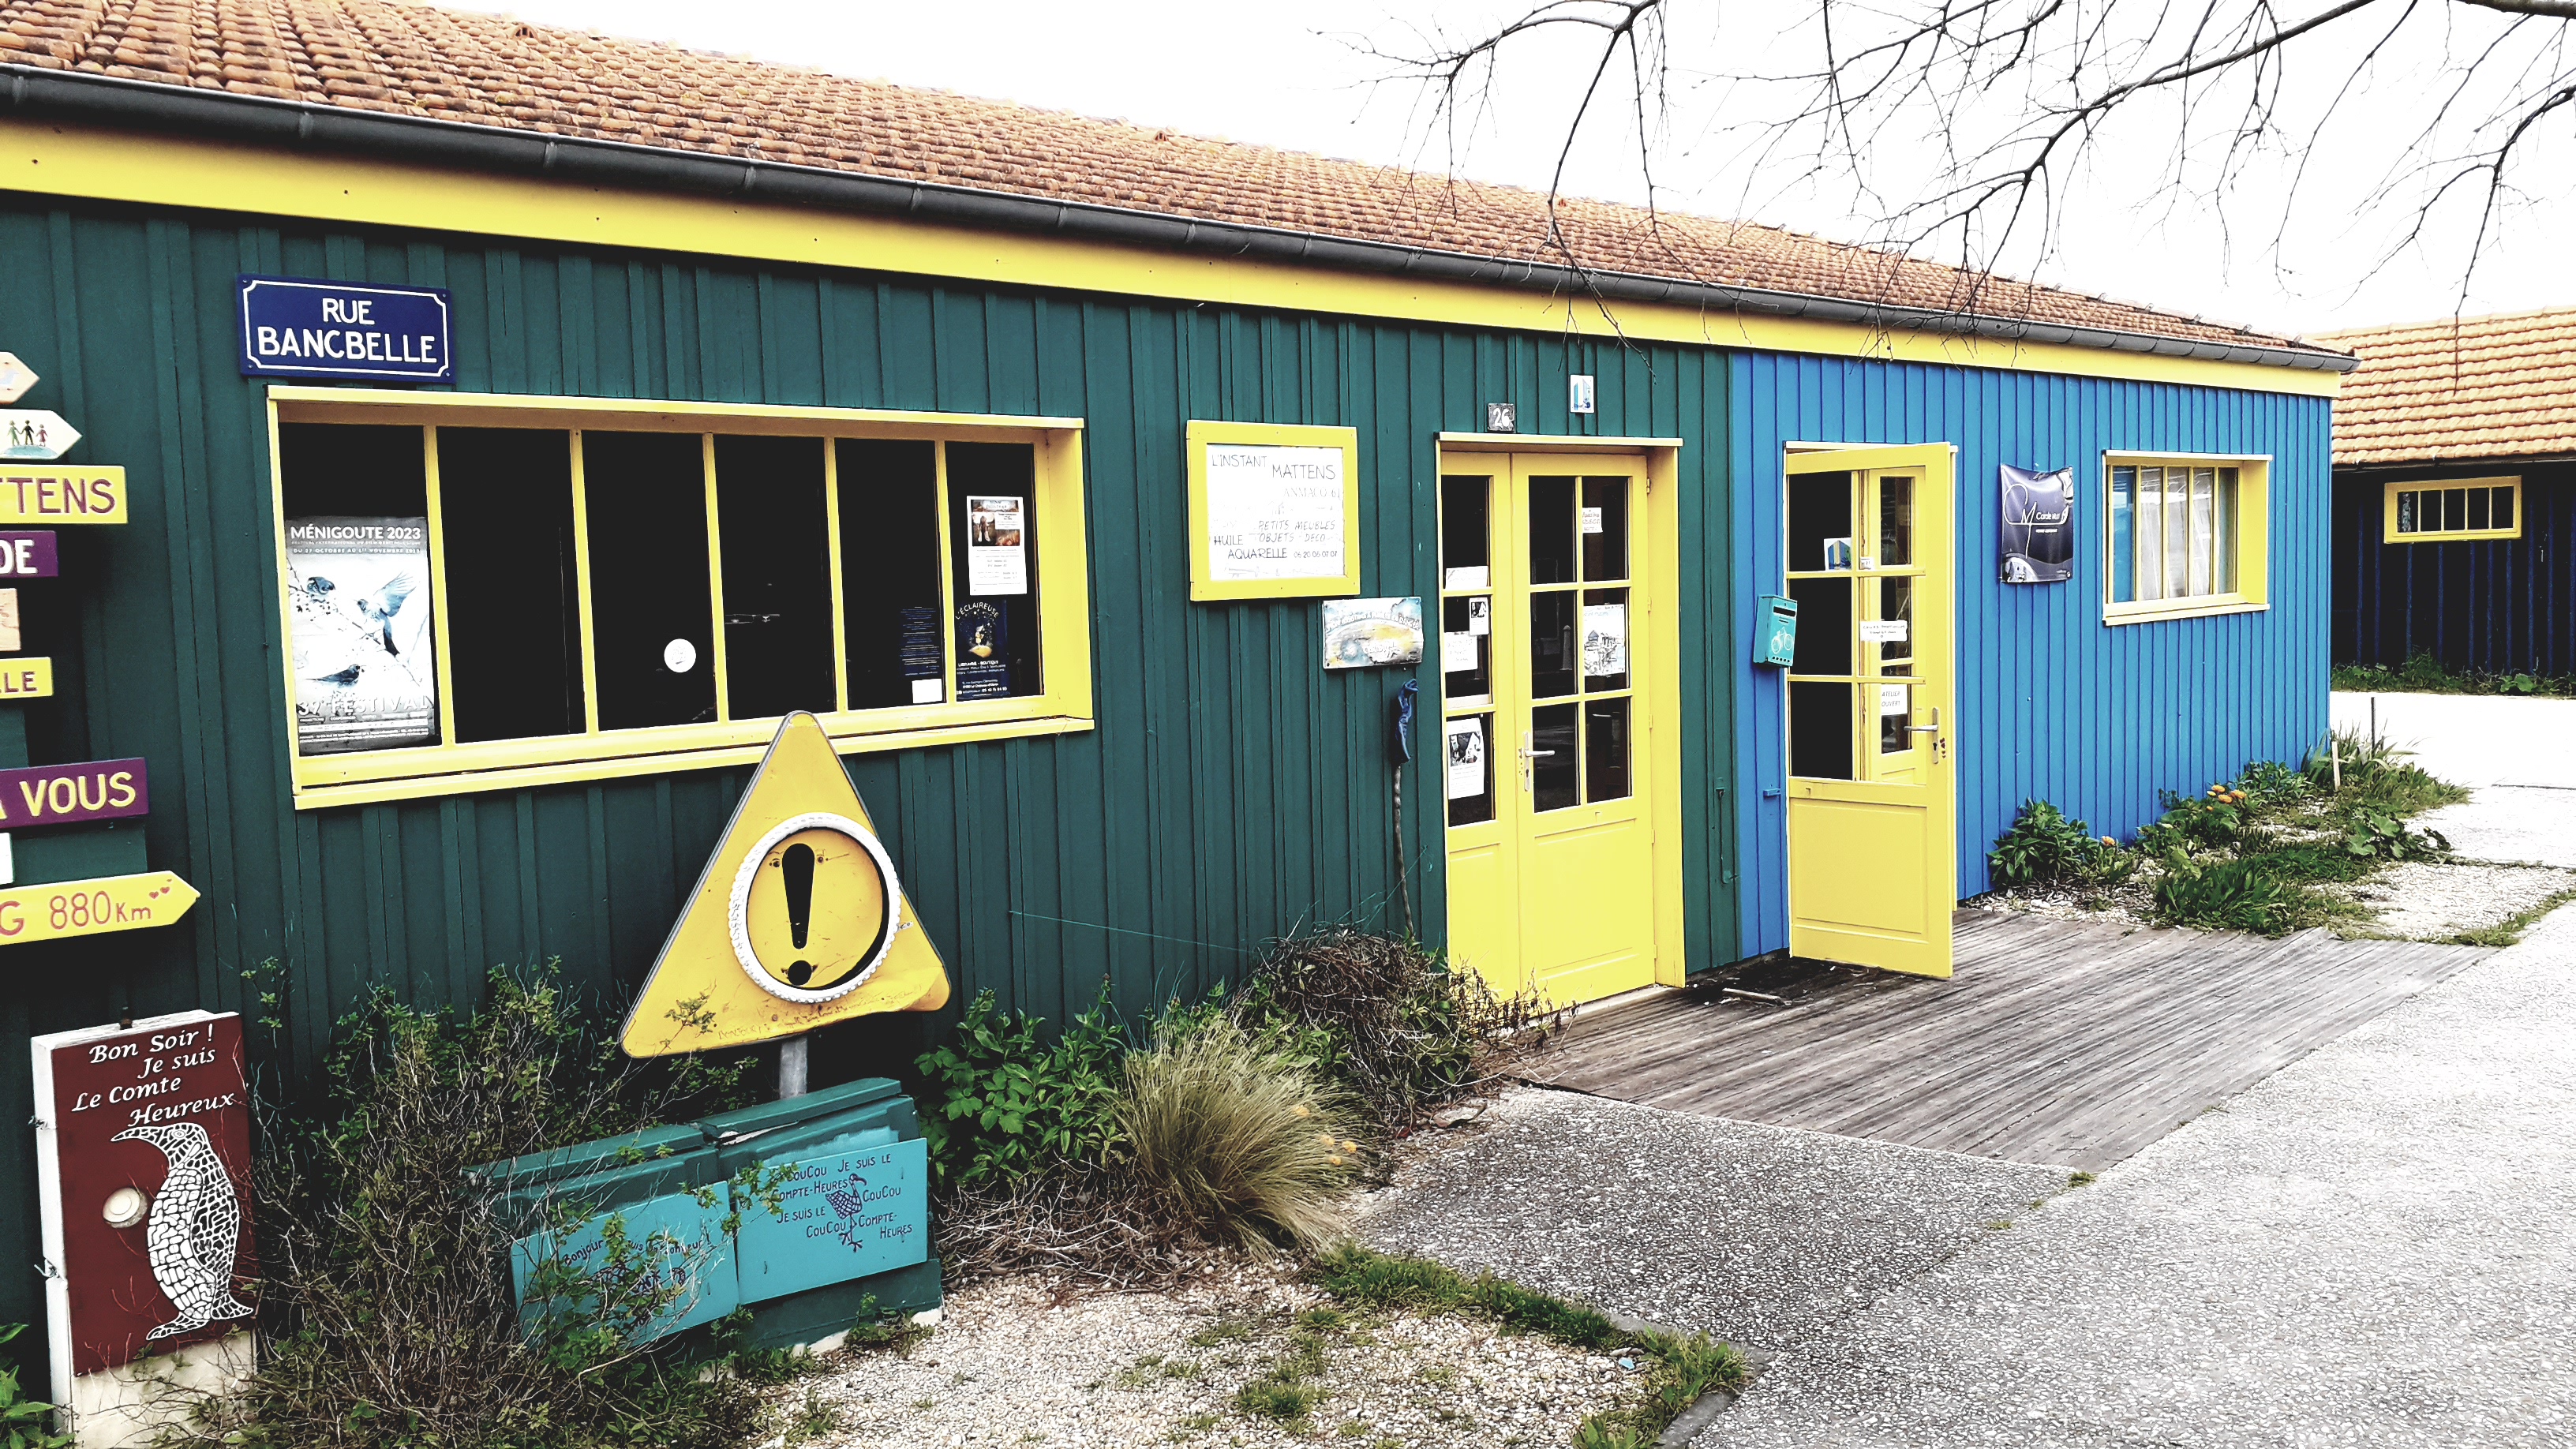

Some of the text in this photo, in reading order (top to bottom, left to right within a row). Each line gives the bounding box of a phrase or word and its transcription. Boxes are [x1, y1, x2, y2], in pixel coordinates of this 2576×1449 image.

[322, 298, 375, 325] RUE
[257, 326, 437, 363] BANCBELLE
[1492, 407, 1511, 428] 26
[1211, 454, 1267, 467] L'INSTANT
[1272, 463, 1336, 480] MATTENS
[0, 477, 115, 514] TENS
[290, 523, 421, 540] MÉNIGOUTE 2023
[1214, 534, 1244, 546] HUILE
[1227, 548, 1288, 560] AQUARELLE
[0, 671, 38, 694] LE
[331, 695, 429, 714] FESTIVAL
[19, 771, 137, 817] VOUS
[88, 1043, 139, 1064] Bon
[149, 1029, 199, 1053] Soir
[137, 1046, 216, 1080] Je suis
[71, 1077, 182, 1112] Le Comte
[127, 1092, 234, 1128] Heureux
[882, 1153, 891, 1163] LE
[815, 1206, 826, 1216] LE
[880, 1224, 913, 1239] HEURES
[562, 1239, 605, 1267] Bonjour
